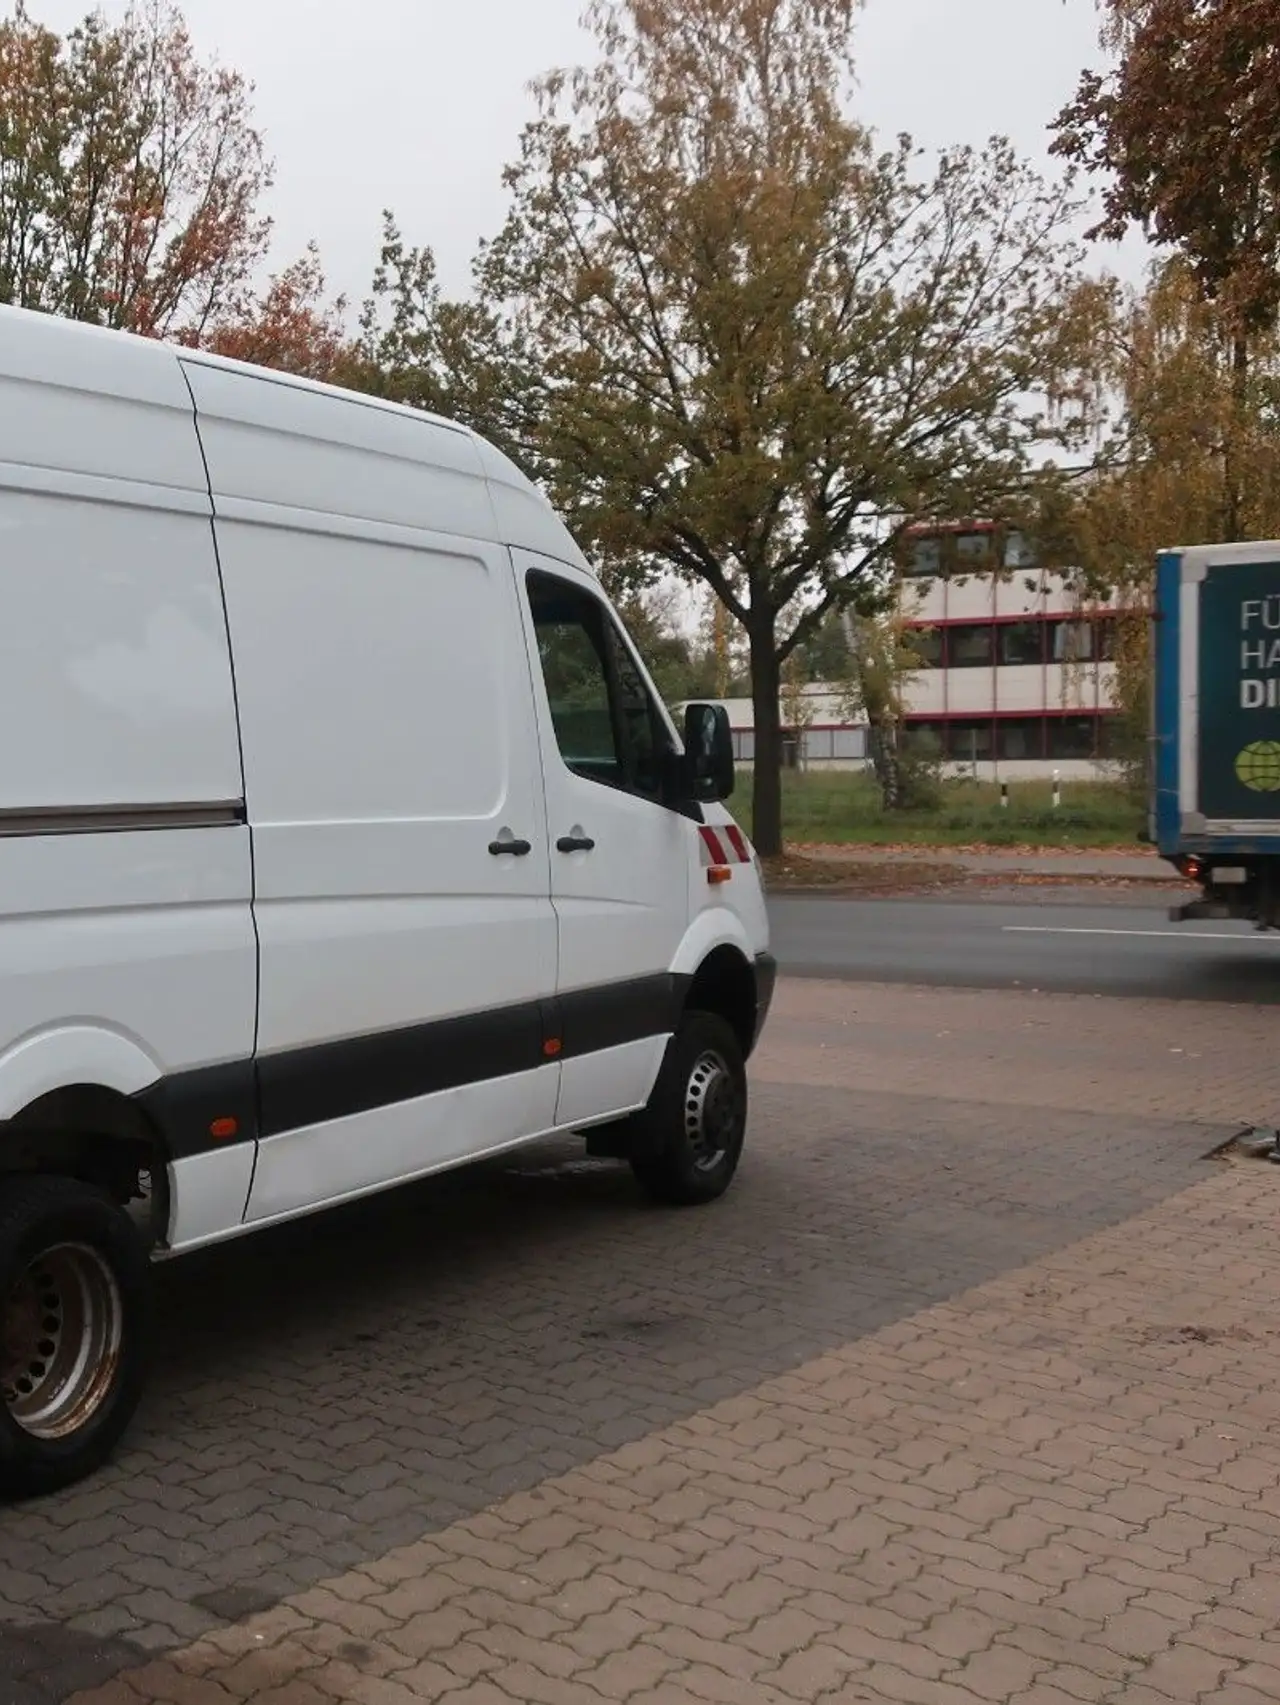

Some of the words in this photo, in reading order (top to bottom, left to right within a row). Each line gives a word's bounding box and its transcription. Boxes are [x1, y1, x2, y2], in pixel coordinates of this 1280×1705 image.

[1242, 594, 1280, 630] FÜ
[1242, 639, 1280, 669] HA
[1241, 679, 1280, 708] DI
